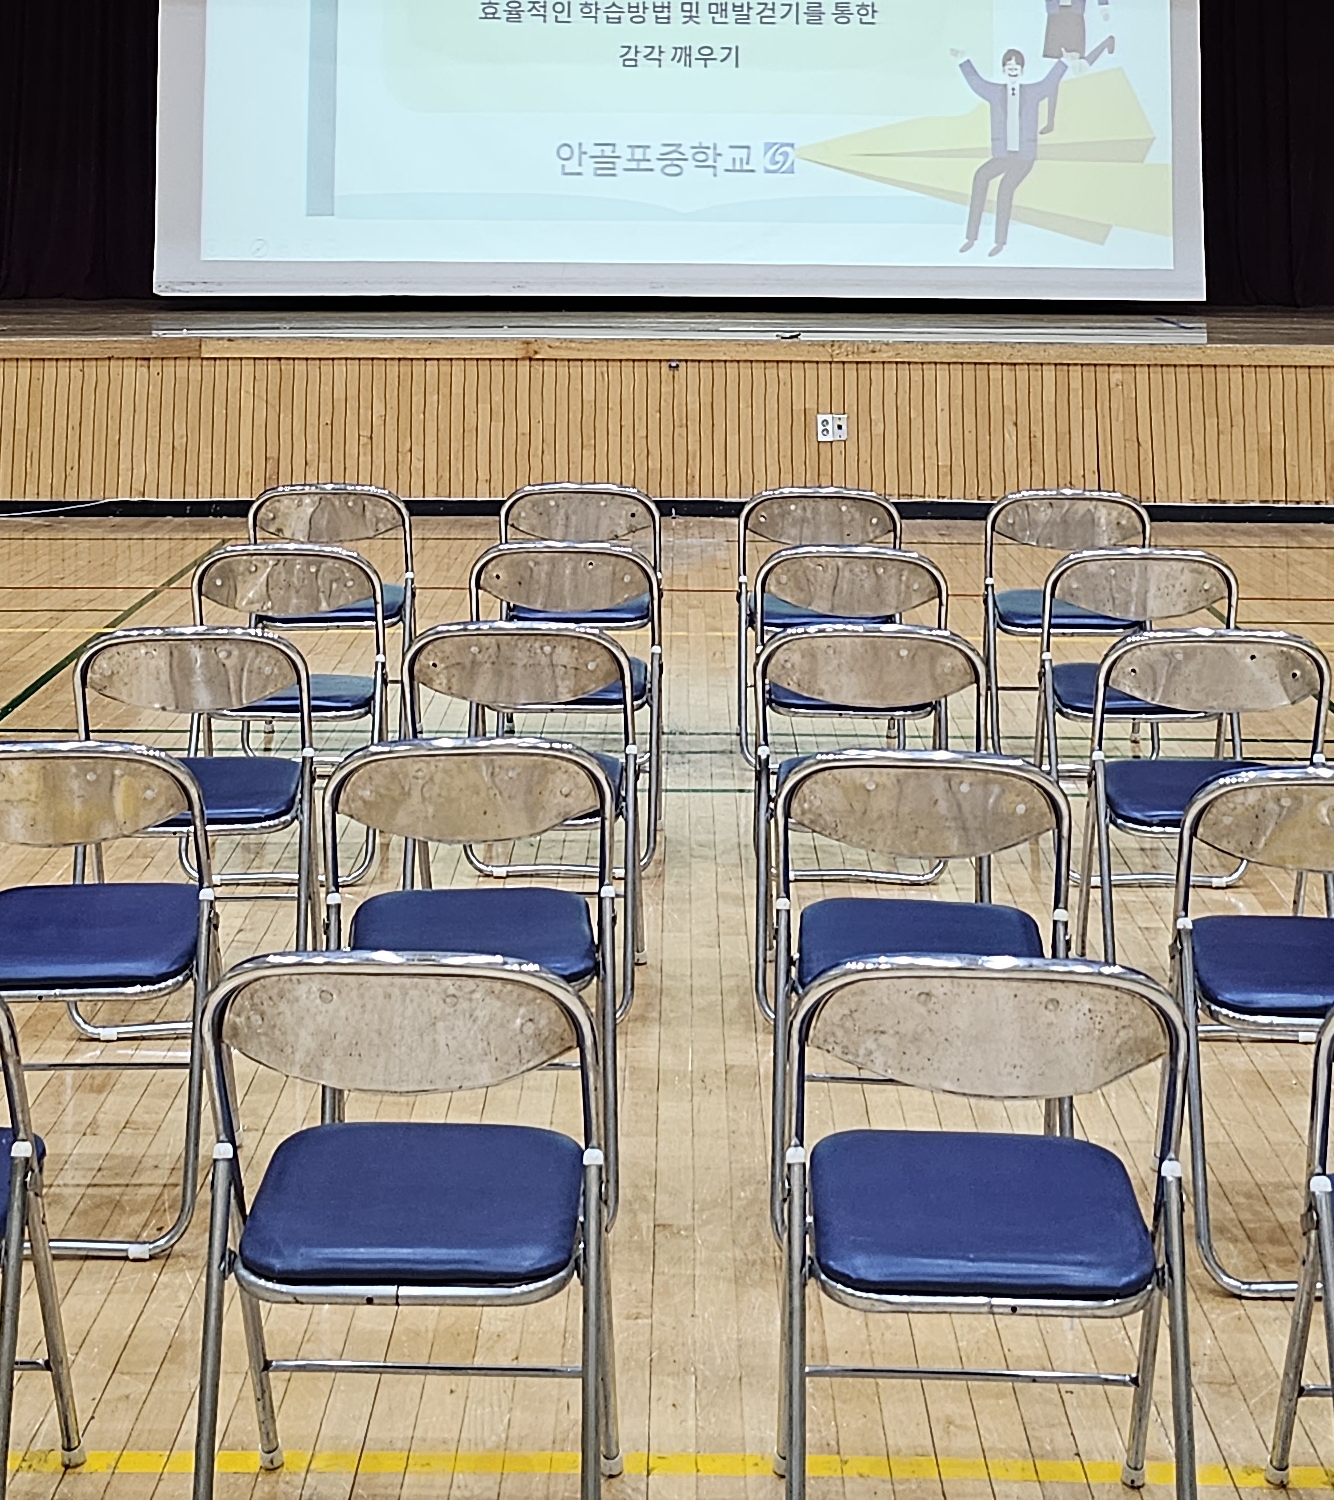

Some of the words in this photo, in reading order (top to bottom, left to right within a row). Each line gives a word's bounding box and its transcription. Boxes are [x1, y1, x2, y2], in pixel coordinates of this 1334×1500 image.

[617, 42, 667, 71] 감각
[669, 42, 742, 71] 깨우기
[555, 141, 757, 179] 안골포중학교
